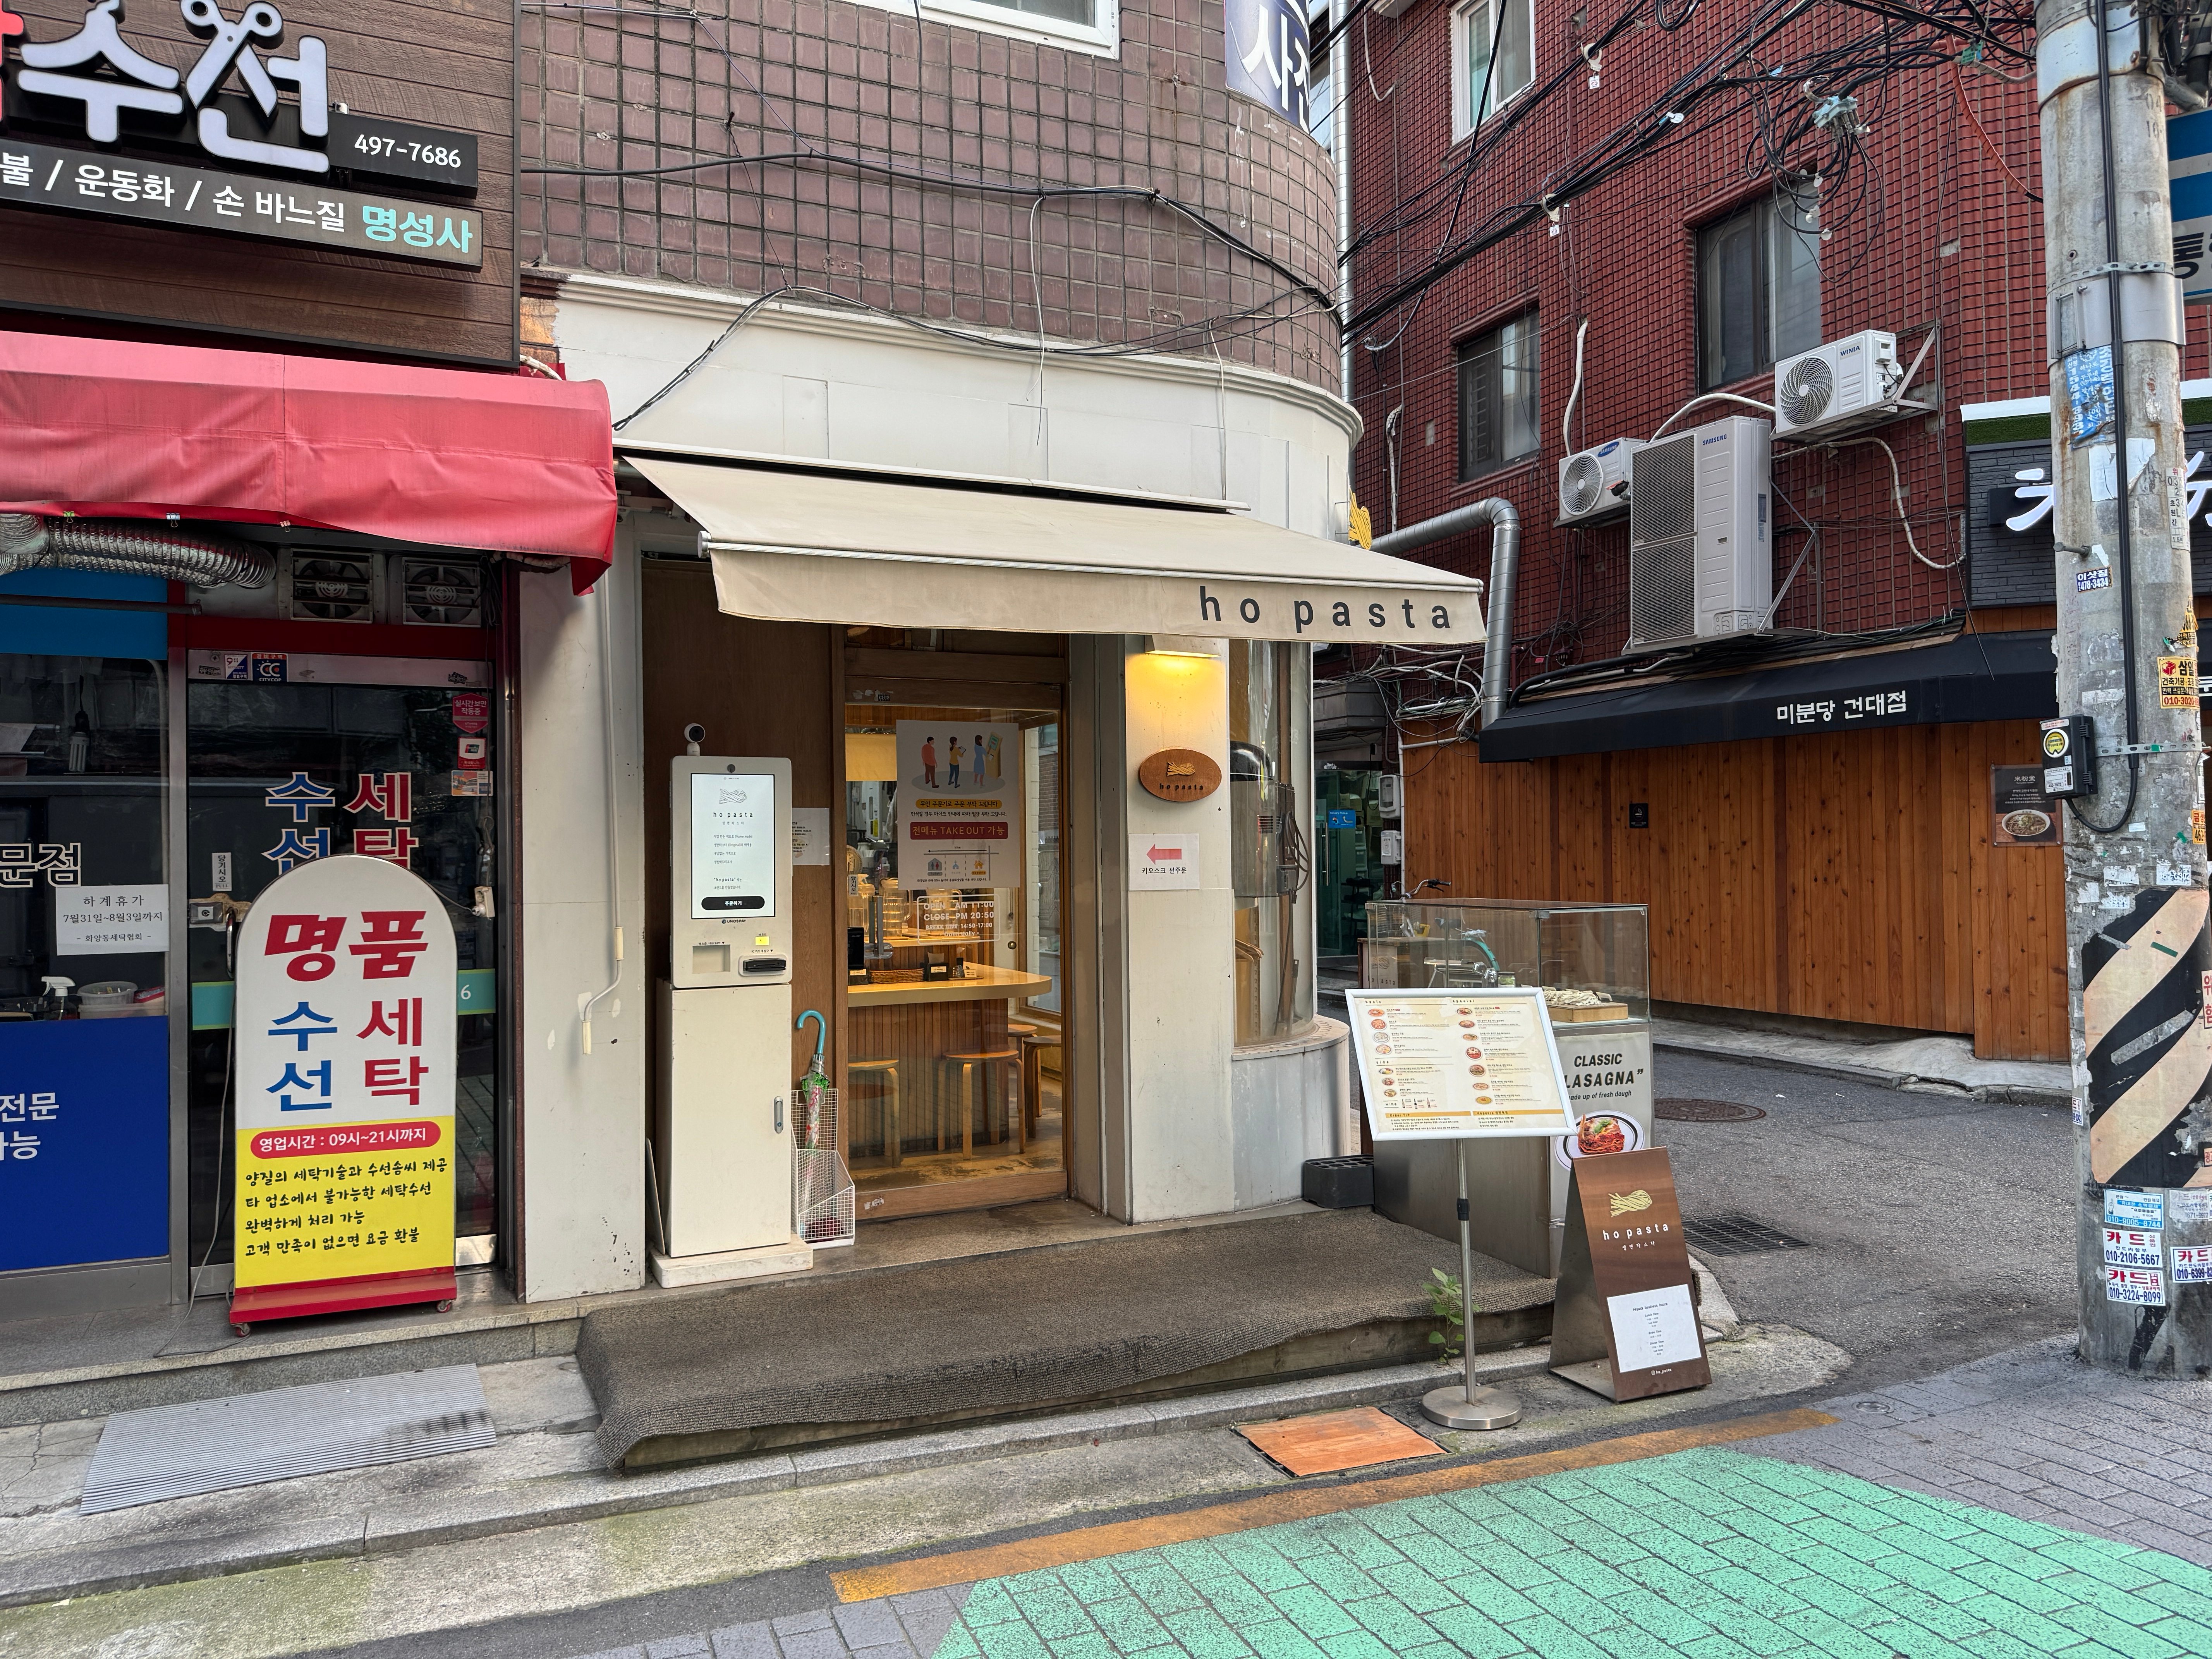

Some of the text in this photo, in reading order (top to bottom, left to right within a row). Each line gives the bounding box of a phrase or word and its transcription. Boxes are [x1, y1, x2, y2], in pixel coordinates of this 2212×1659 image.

[18, 0, 329, 173] 수선
[354, 134, 461, 168] 497-7686
[2, 153, 33, 187] 불
[75, 164, 175, 207] 운동화
[213, 185, 244, 217] 손
[256, 192, 345, 232] 바느질
[362, 205, 473, 253] 명성사
[1840, 345, 1860, 357] WINIA
[1703, 434, 1727, 446] SAMSUNG
[1600, 444, 1617, 455] SAMSUNG
[2077, 569, 2108, 581] 이삿짐
[1200, 586, 1451, 633] ho pasta
[2178, 661, 2194, 677] 삼일
[1777, 690, 1906, 725] 미분당 건대점
[2164, 696, 2199, 705] 010-3020-
[912, 826, 938, 836] 전메뉴
[988, 826, 1005, 835] 가능
[218, 855, 227, 882] 당기시오
[83, 895, 144, 907] 하계휴가
[63, 912, 163, 924] 7월31일~8월3일까지
[265, 911, 429, 982] 명품
[460, 984, 471, 1000] 6
[266, 1001, 338, 1111] 수선
[356, 997, 429, 1105] 세탁
[1574, 1053, 1622, 1067] CLASSIC
[1615, 1090, 1632, 1098] dough
[0, 1131, 41, 1161] 능
[259, 1135, 316, 1152] 영업시간
[329, 1127, 426, 1146] 09시~21시까지
[246, 1170, 287, 1187] 양질의
[294, 1164, 362, 1182] 세탁기술과
[422, 1158, 448, 1172] 제공
[245, 1181, 431, 1209] 타 업소에서 불가능한 세탁수선
[245, 1210, 365, 1234] 완벽하게 처리 가능
[2107, 1215, 2161, 1228] 010-9005-8744
[1602, 1223, 1669, 1240] ho pasta
[2107, 1231, 2145, 1246] 카드
[245, 1227, 420, 1256] 고객 만족이 없으면 요금 환불
[2106, 1250, 2160, 1265] 010-2106-5667
[2108, 1269, 2148, 1285] 카드
[2109, 1286, 2161, 1303] 010-3224-8099
